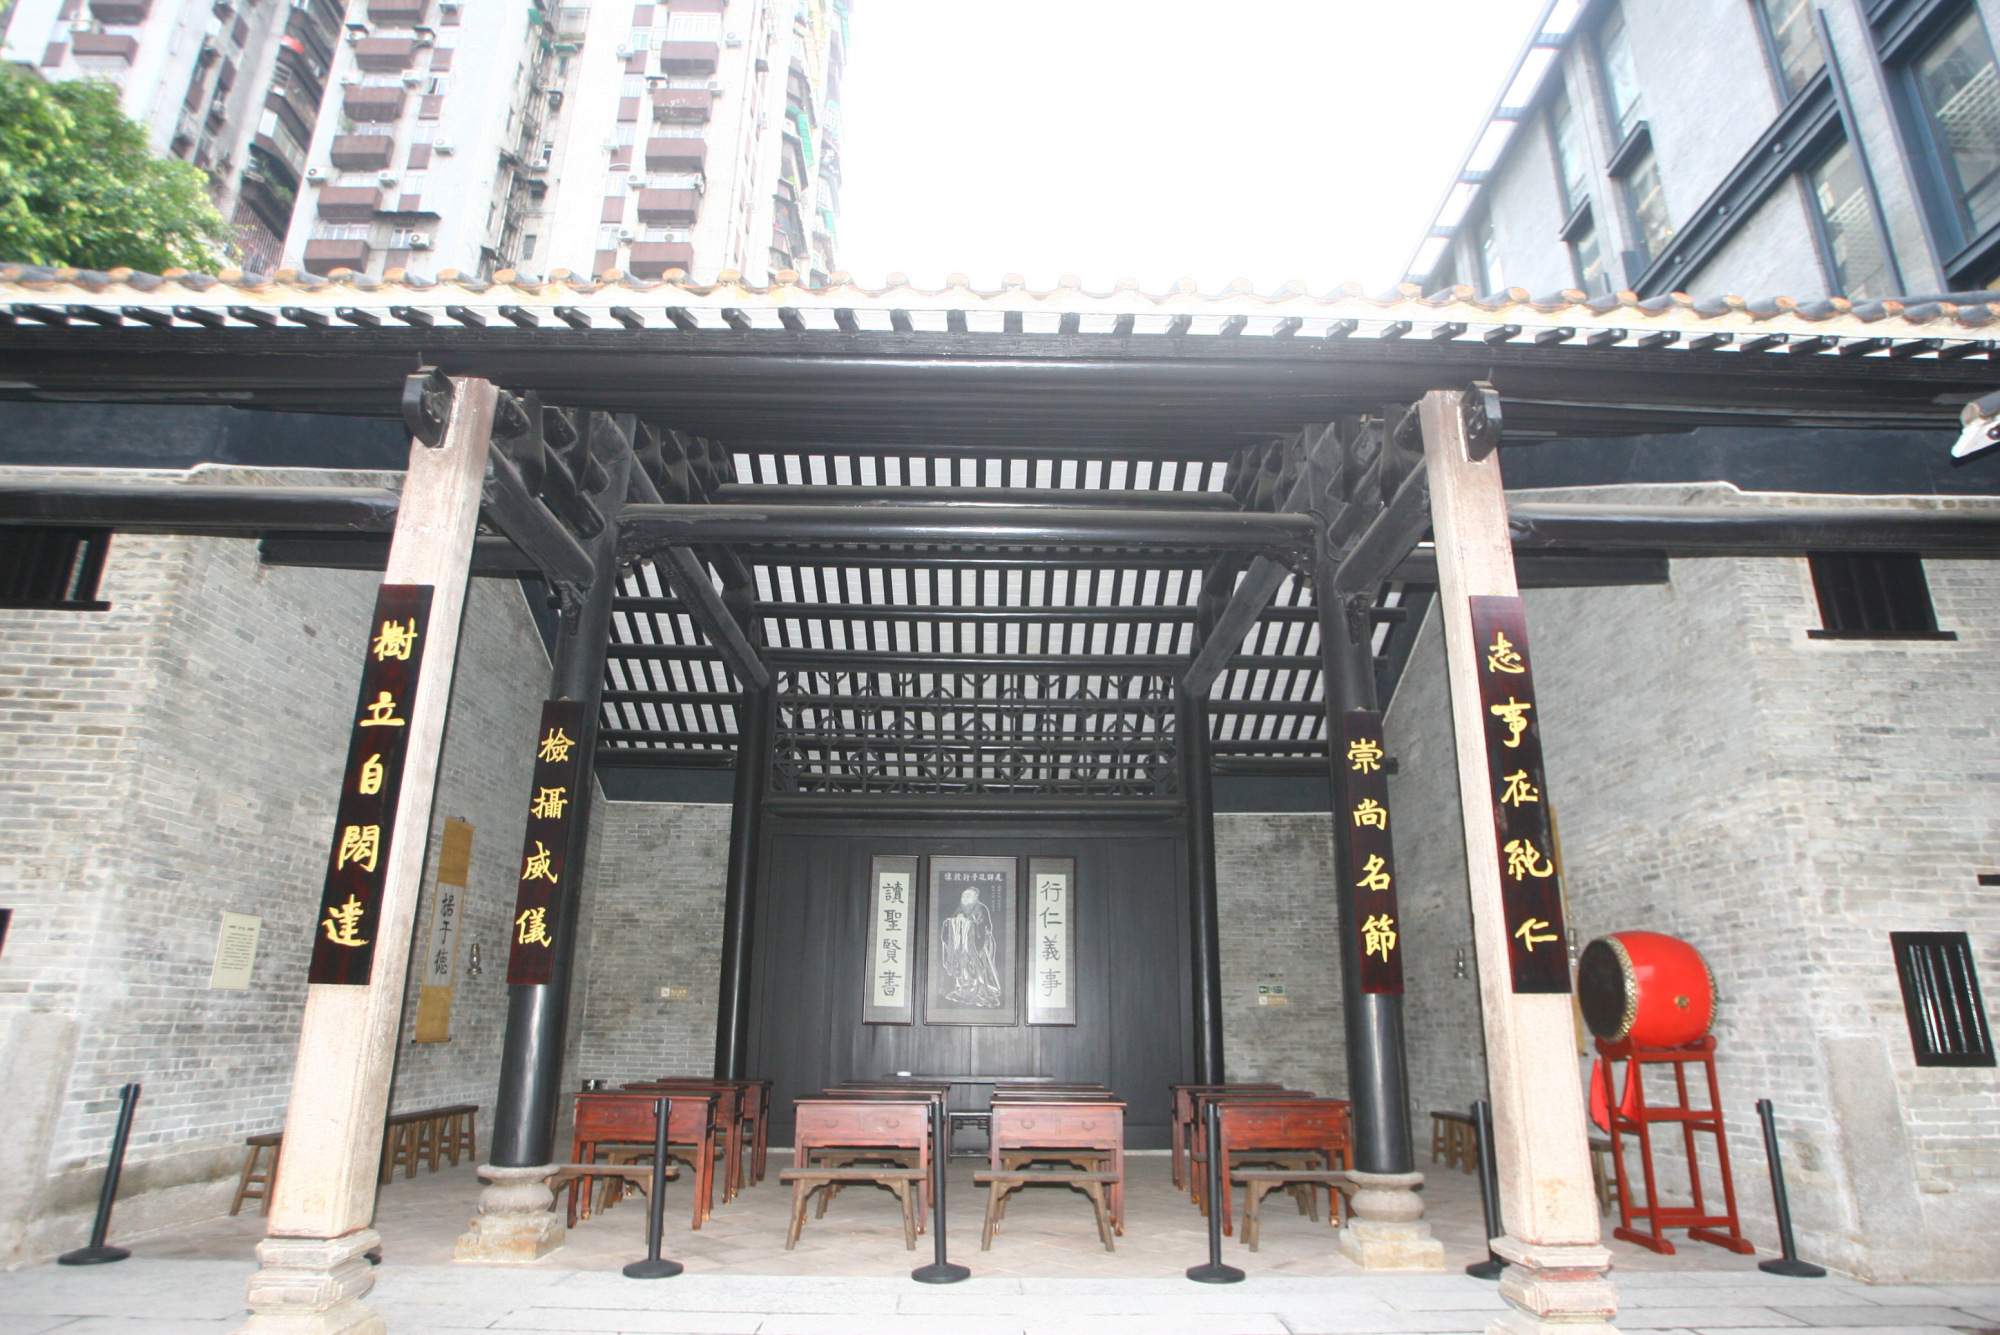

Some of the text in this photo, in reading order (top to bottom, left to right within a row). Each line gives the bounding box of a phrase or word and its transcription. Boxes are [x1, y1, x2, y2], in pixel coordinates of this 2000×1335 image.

[516, 728, 575, 947] 檢攝威儀
[1347, 738, 1397, 962] 崇尚名節
[1487, 632, 1557, 952] 志事在純仁
[879, 881, 905, 997] 讀聖賢書
[1039, 881, 1063, 997] 行仁義事
